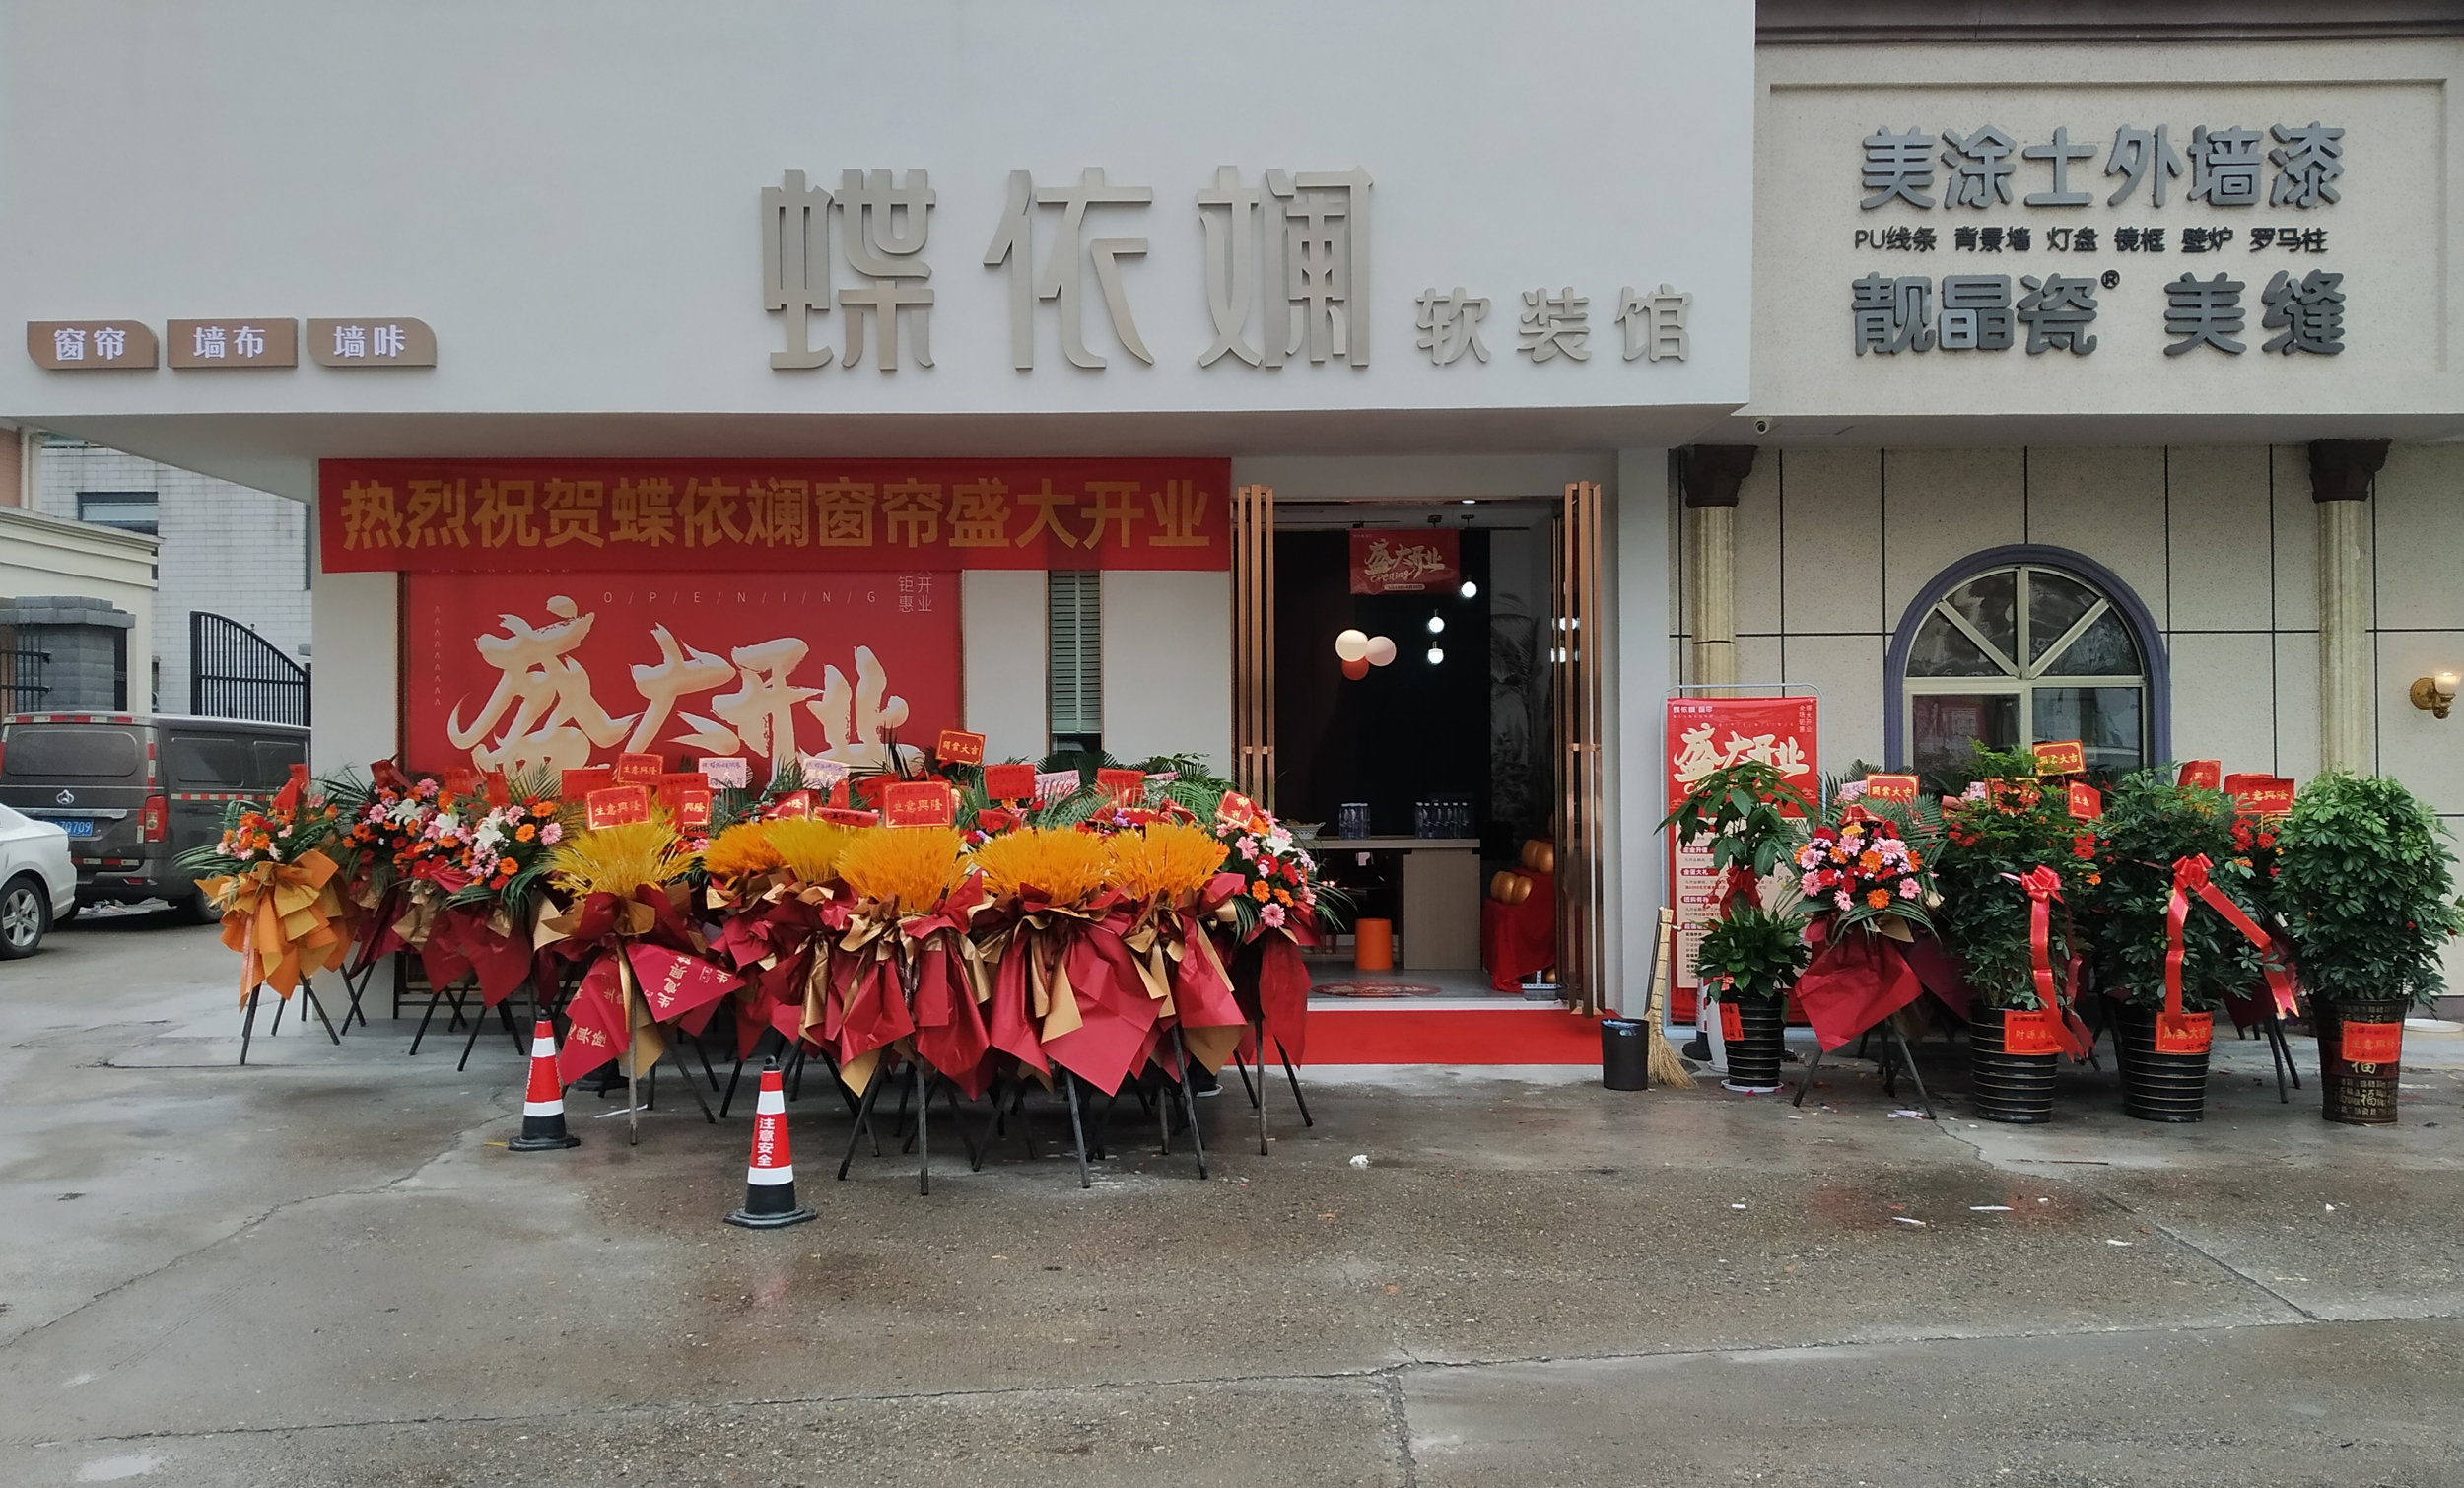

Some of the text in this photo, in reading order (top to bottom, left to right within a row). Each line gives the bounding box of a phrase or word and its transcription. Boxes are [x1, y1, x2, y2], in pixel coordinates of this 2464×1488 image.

[1860, 120, 2346, 210] 美涂士外墙漆
[1854, 225, 2329, 254] PU线条 背景墙 灯盘 镜框 壁炉 罗马柱
[1414, 282, 1694, 366] 软装馆
[2163, 268, 2347, 356] 美缝
[53, 327, 128, 362] 窗帘
[192, 324, 267, 359] 墙布
[332, 324, 406, 359] 墙咔
[339, 476, 1211, 552] 热烈祝贺蝶依斓窗帘盛大开业
[1364, 538, 1446, 580] 盛大开业
[447, 592, 926, 794] 盛大开业
[1674, 721, 1811, 783] 盛大开业
[756, 1117, 776, 1167] 注意安全
